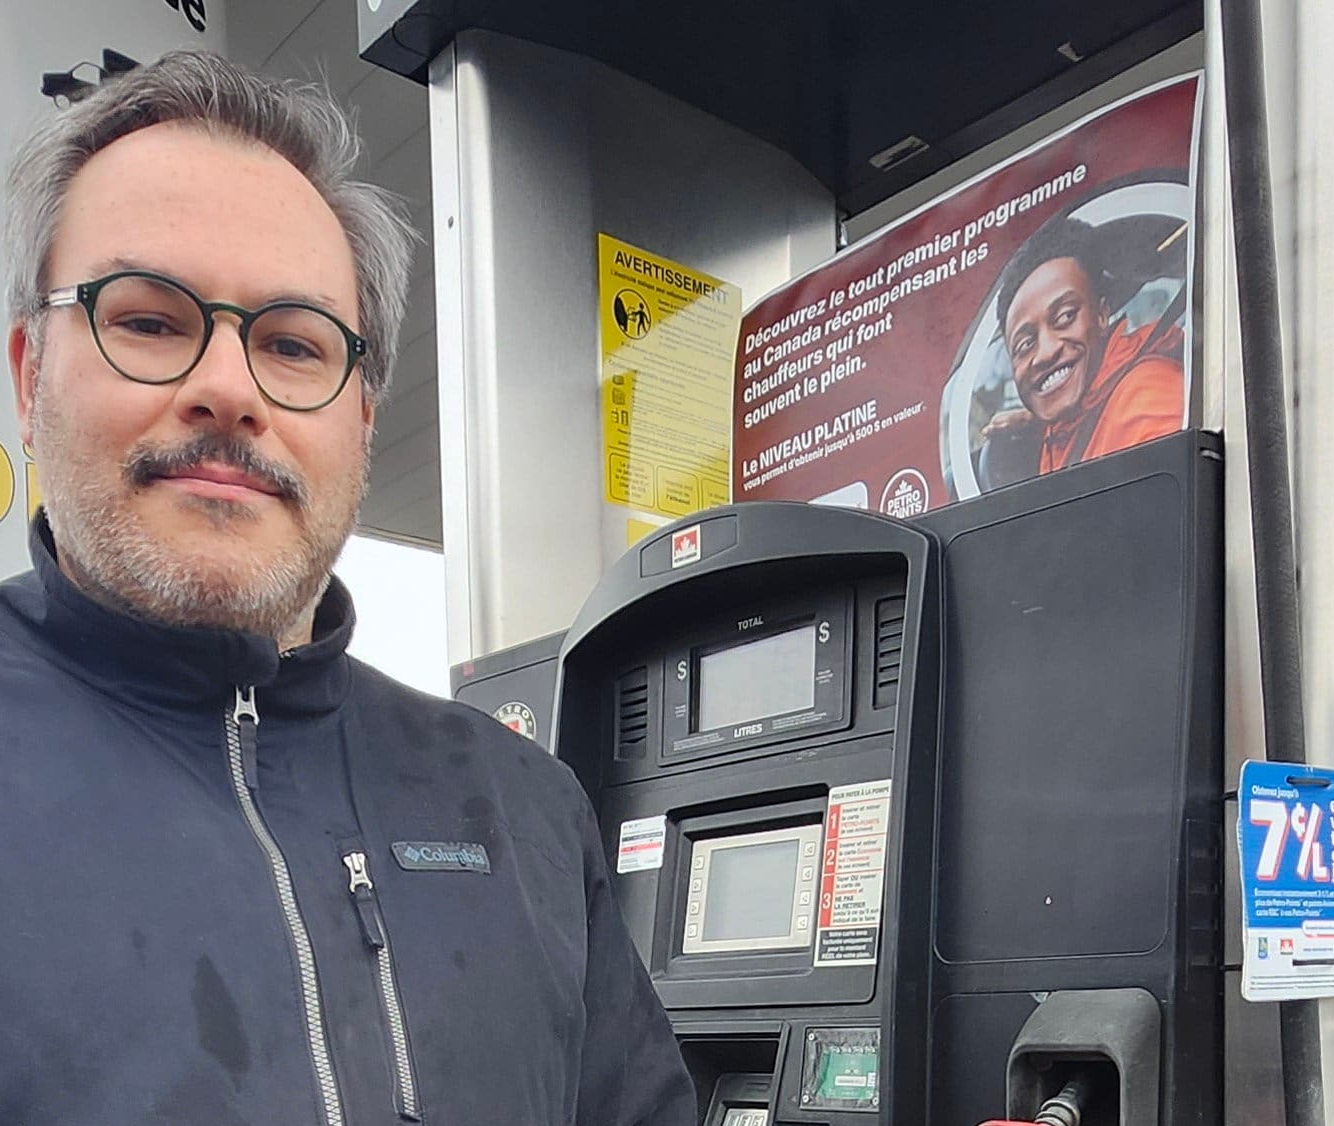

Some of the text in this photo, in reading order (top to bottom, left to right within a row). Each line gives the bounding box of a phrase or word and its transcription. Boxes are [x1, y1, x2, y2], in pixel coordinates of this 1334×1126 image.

[745, 303, 825, 355] Découvrez
[830, 290, 845, 307] le
[848, 269, 885, 299] tout
[887, 229, 960, 282] premier
[964, 163, 1087, 244] programme
[615, 250, 729, 303] AVERTISSEMENT
[744, 359, 762, 379] au
[763, 322, 821, 366] Canada
[824, 259, 958, 332] récompensant
[961, 241, 989, 272] les
[743, 346, 824, 403] chauffeurs
[826, 334, 854, 363] qui
[856, 313, 893, 342] font
[744, 355, 867, 430] souvent le plein.
[742, 399, 878, 479] Le NIVEAU PLATINE
[743, 476, 761, 492] vous
[761, 465, 787, 486] permet
[887, 490, 921, 512] PETRO
[737, 616, 764, 631] TOTAL
[818, 620, 830, 643] $
[677, 660, 688, 682] $
[498, 704, 530, 720] ETRO
[733, 723, 763, 738] LITRES
[830, 813, 838, 830] 1
[420, 847, 485, 865] Columbia
[826, 849, 835, 866] 2
[822, 893, 831, 909] 3
